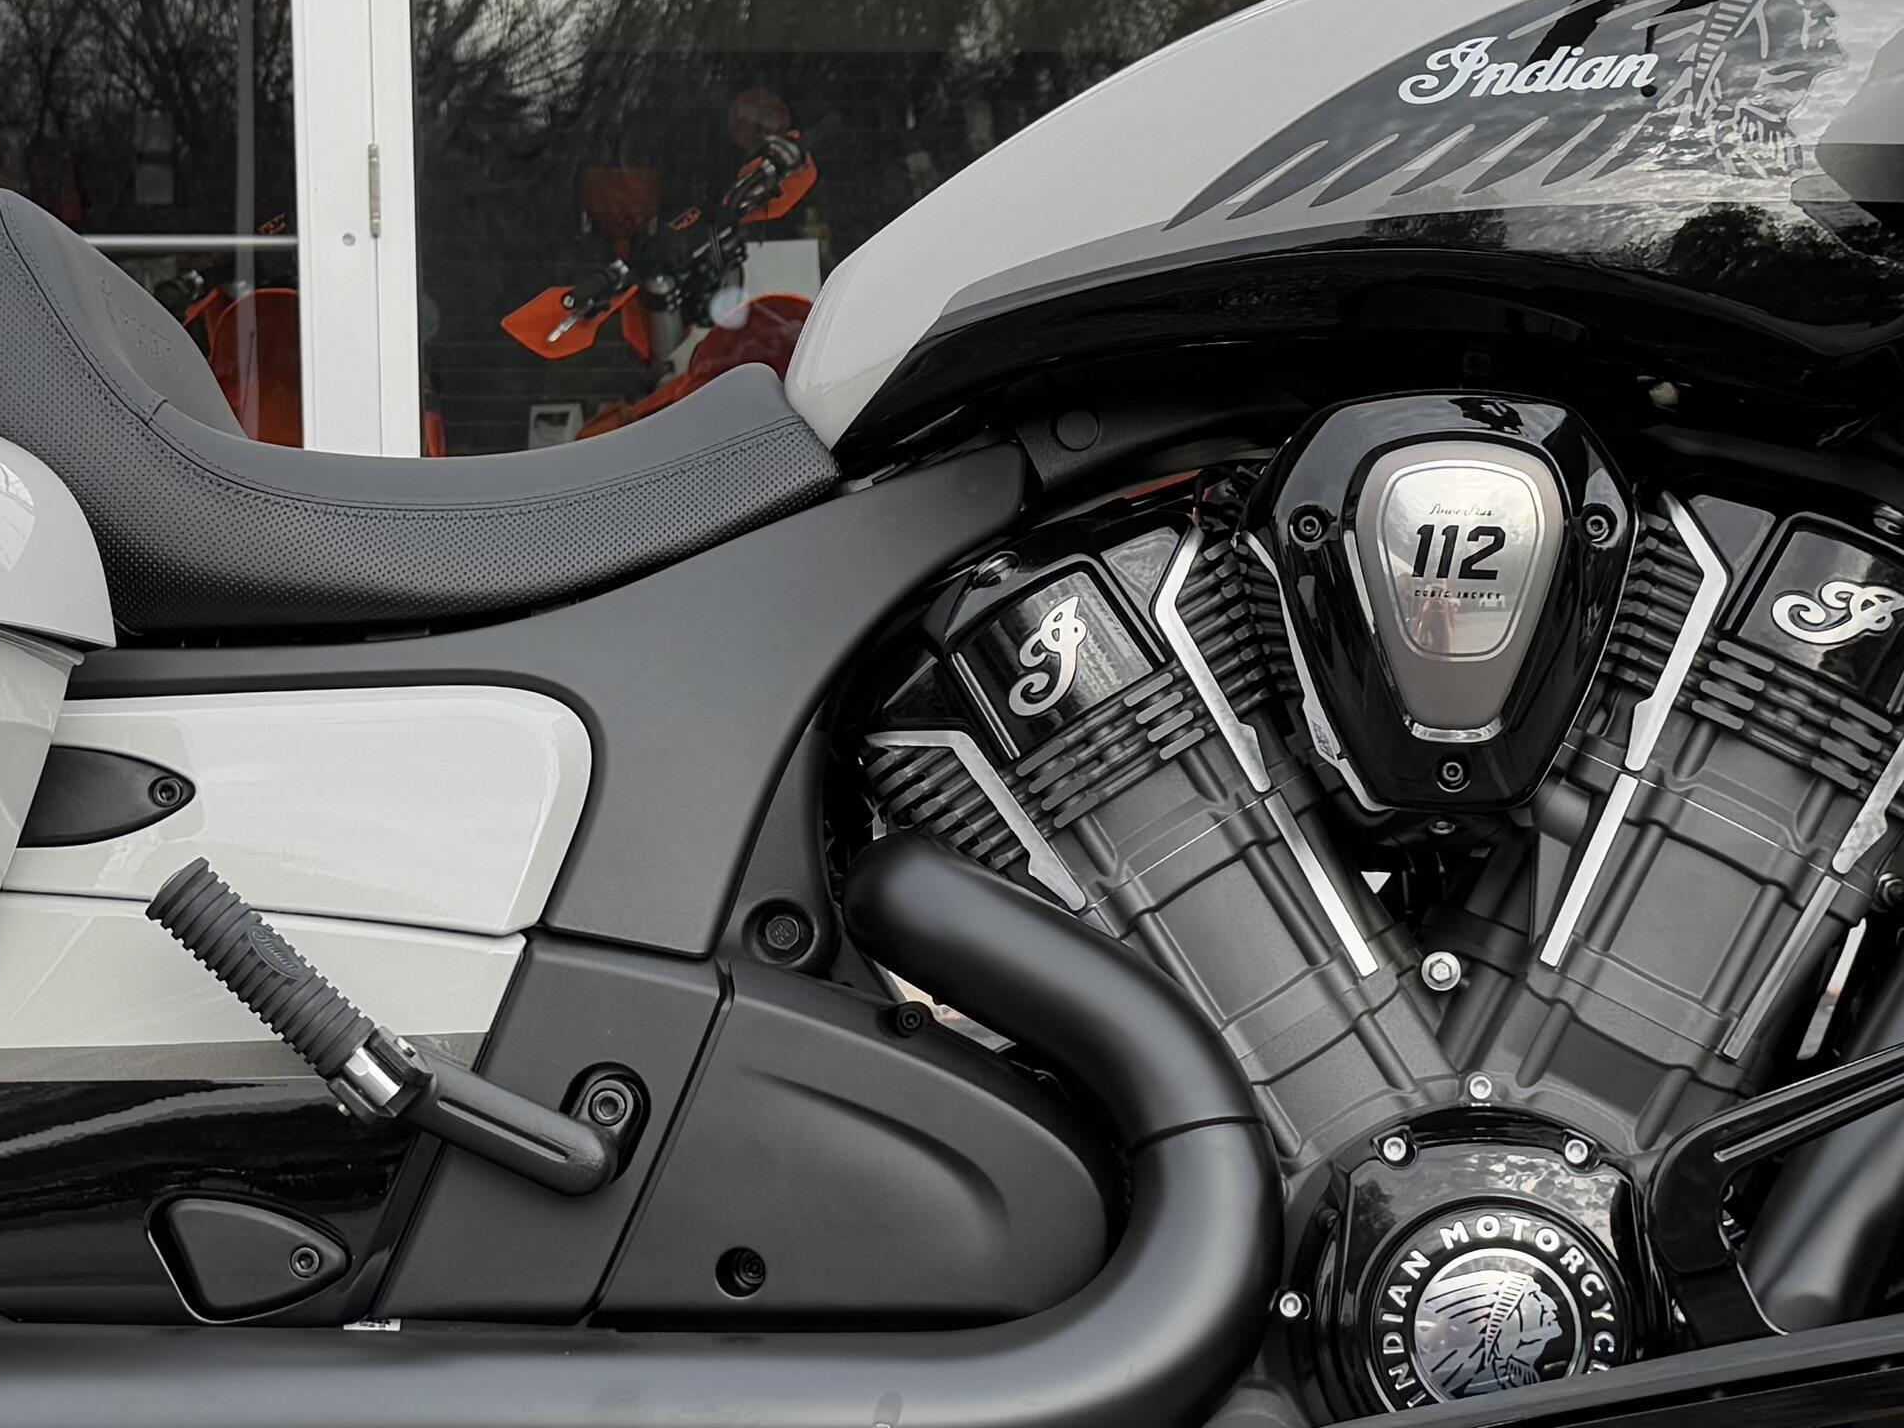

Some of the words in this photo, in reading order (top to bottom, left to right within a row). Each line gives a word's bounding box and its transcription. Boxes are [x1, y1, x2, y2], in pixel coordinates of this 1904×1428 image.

[1398, 36, 1659, 105] Indian
[1411, 524, 1506, 580] 112
[1382, 1250, 1431, 1408] INDIAN
[1440, 1215, 1615, 1376] MOTORCYCL
